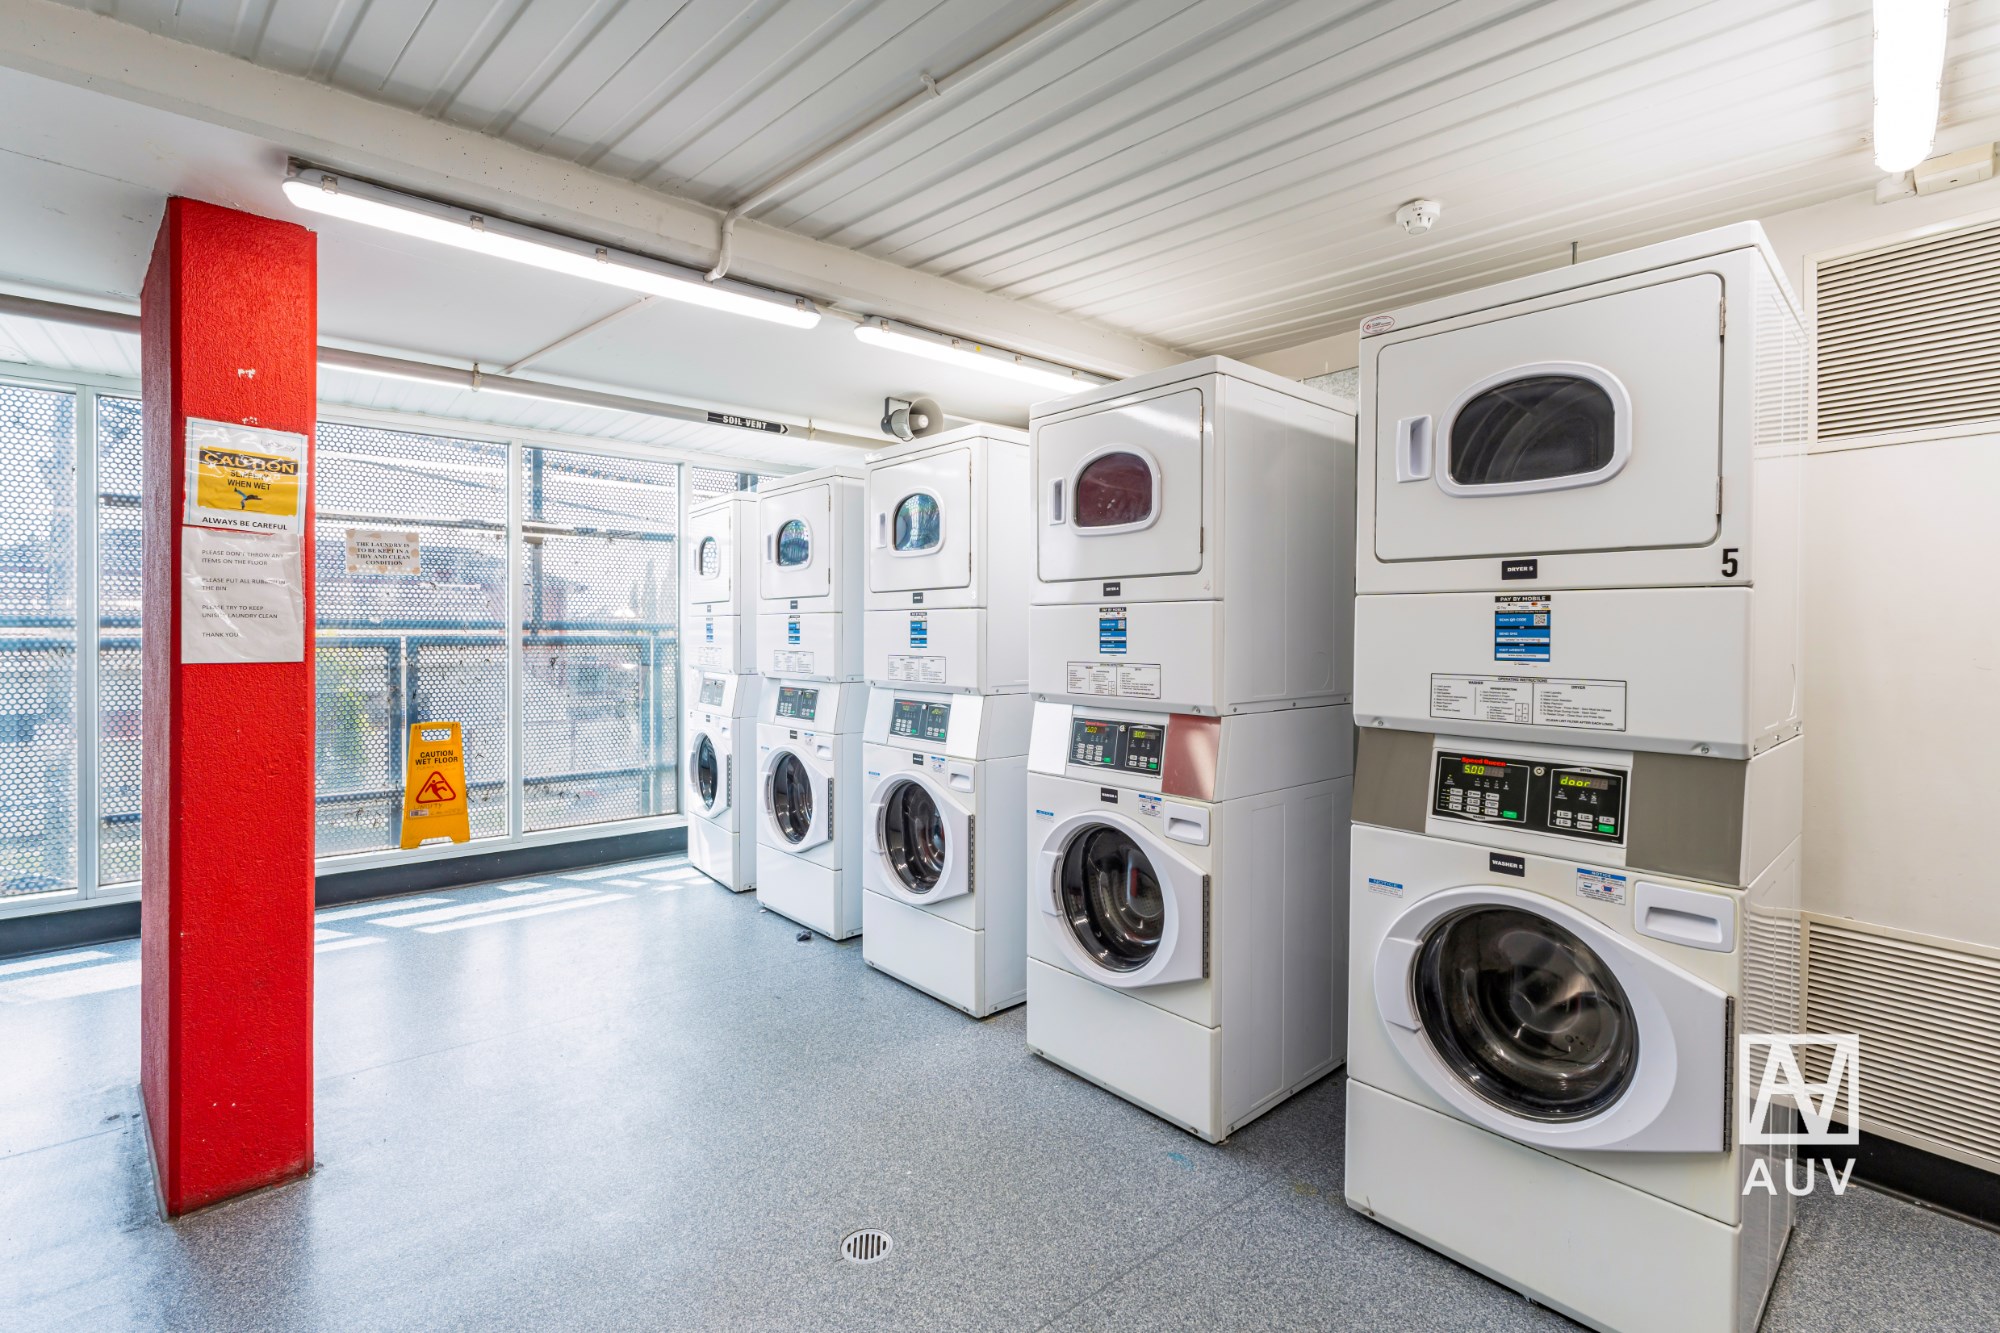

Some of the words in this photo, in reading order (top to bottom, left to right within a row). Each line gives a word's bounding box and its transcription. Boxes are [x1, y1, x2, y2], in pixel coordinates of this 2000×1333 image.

[722, 415, 743, 426] SOIL
[745, 418, 767, 430] VENT
[204, 453, 294, 474] CAUTION
[227, 479, 252, 488] WHEN
[254, 482, 271, 491] WET
[202, 516, 237, 526] ALWAYS
[252, 521, 288, 530] CAREFUL
[1722, 548, 1738, 577] 5
[420, 750, 453, 758] CAUTION
[1464, 765, 1484, 775] 5.00
[1560, 776, 1590, 787] door
[1492, 859, 1517, 868] WASHER
